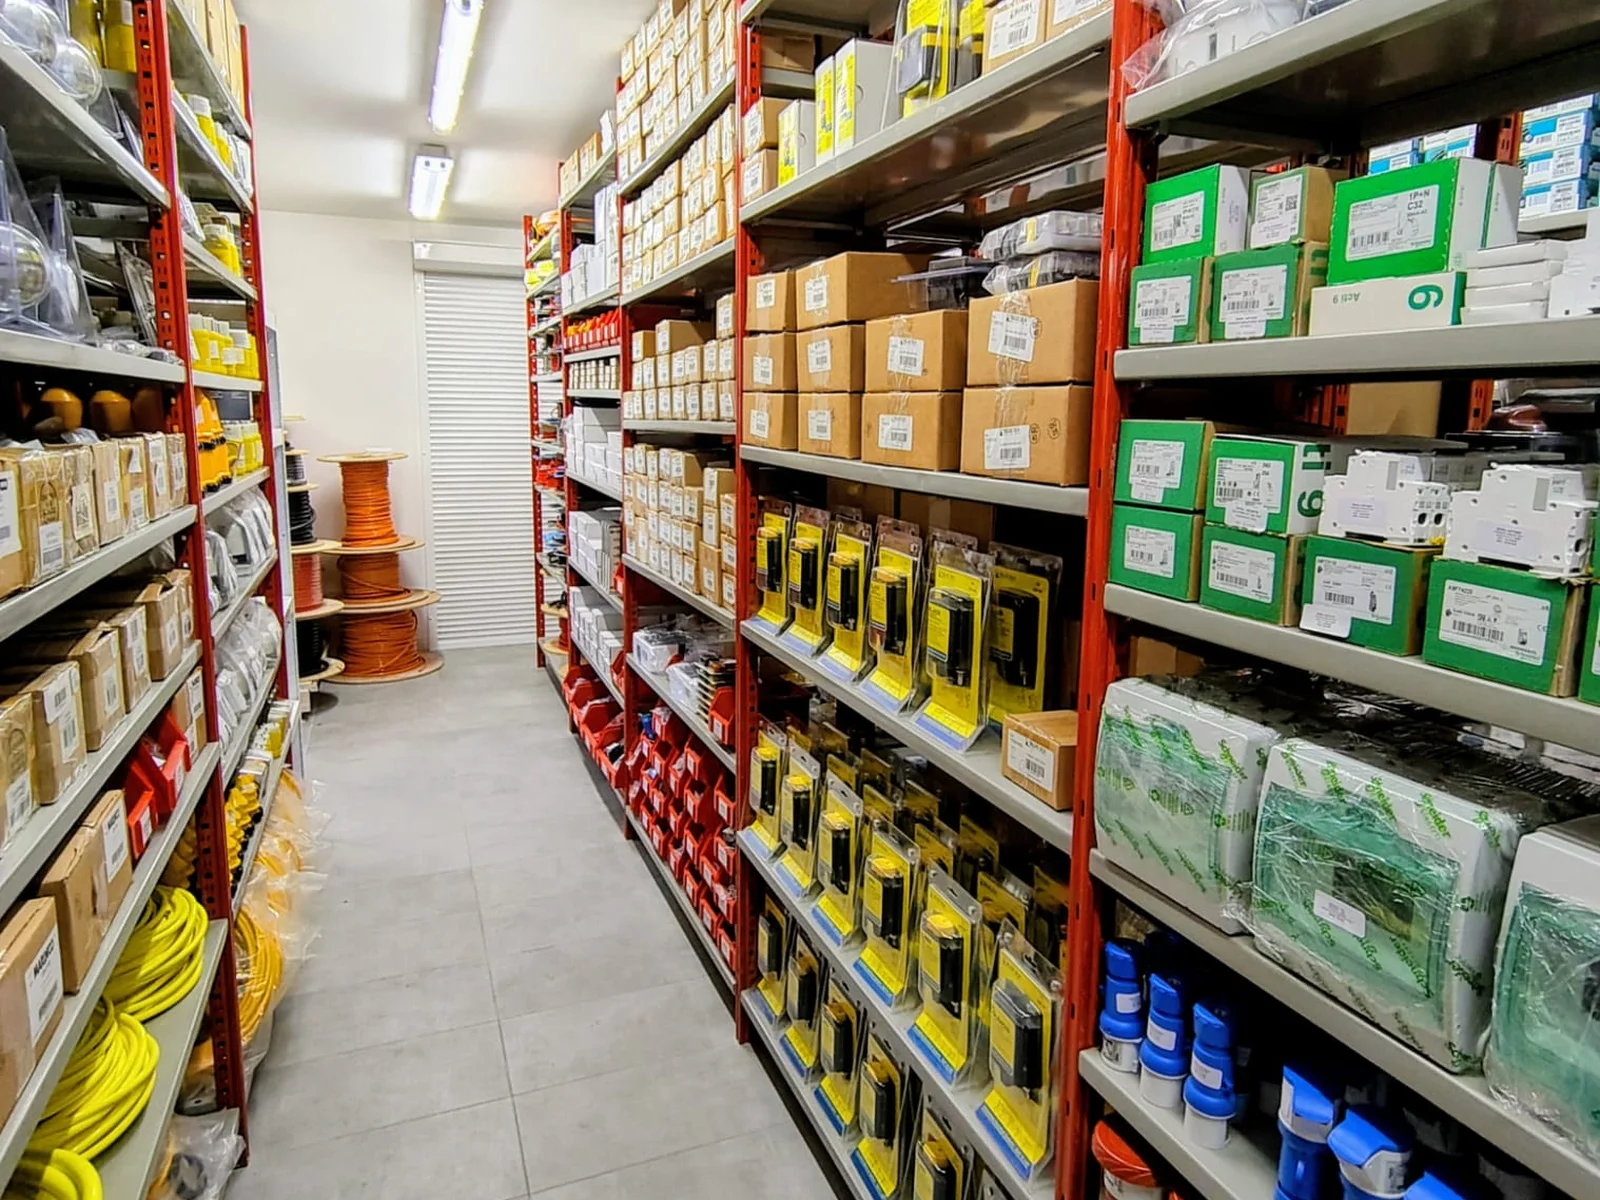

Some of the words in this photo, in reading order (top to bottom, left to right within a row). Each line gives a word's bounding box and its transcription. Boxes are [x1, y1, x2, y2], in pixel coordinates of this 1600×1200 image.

[1409, 189, 1430, 200] 1P+N
[1407, 201, 1424, 211] C32
[1340, 291, 1361, 303] Acti
